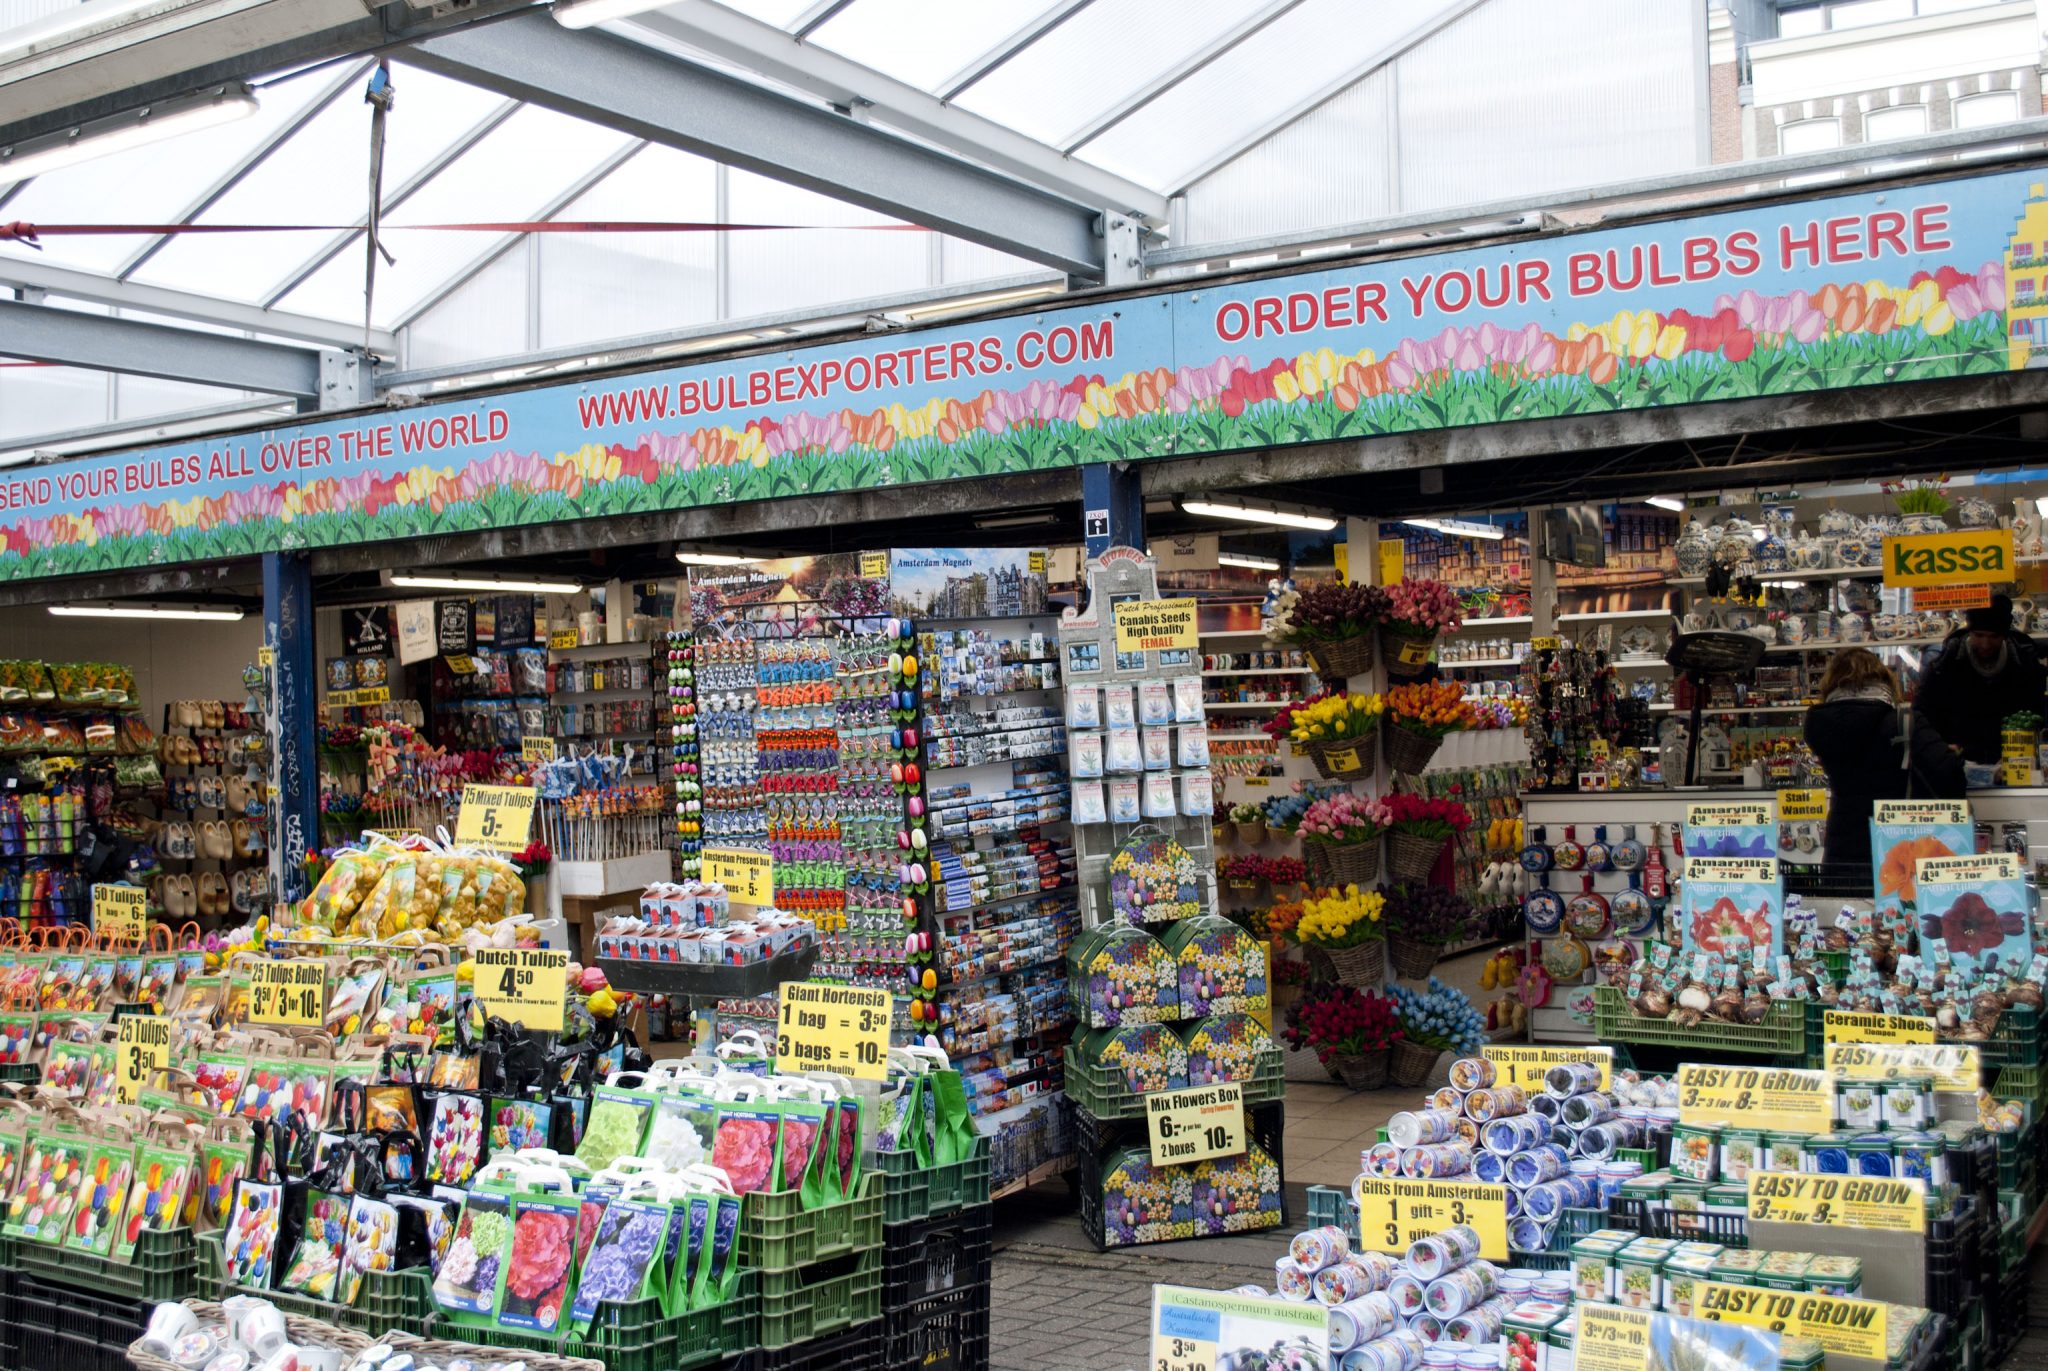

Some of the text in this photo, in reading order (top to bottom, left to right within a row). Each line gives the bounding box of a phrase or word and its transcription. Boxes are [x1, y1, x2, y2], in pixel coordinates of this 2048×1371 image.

[1214, 205, 1952, 342] ORDER YOUR BULBS HERE
[578, 320, 1114, 429] WWW.BULBEXPORTERS.COM
[0, 408, 510, 511] SEND YOUR BULBS ALL OVER THE WORLD
[897, 558, 940, 569] Amsterdam
[942, 558, 973, 568] Magnets
[1100, 548, 1144, 567] growers
[1894, 543, 2004, 575] kassa
[698, 573, 786, 586] Amsterdam Magnets
[1115, 600, 1195, 613] Dutch Professionals
[1120, 612, 1190, 626] Canabis Seeds
[1127, 625, 1184, 638] High Quality
[357, 644, 383, 654] HOLLAND
[1140, 637, 1174, 649] FEMALE
[524, 739, 552, 750] Mills
[463, 787, 534, 809] 75 Mixed Tulips
[1785, 793, 1810, 802] Staff
[1693, 805, 1766, 814] Amaryllis
[1782, 805, 1823, 815] Wanted
[1881, 803, 1962, 812] Amaryllis
[1727, 817, 1742, 825] for
[1918, 815, 1935, 823] for
[704, 852, 770, 866] Amsterdam Present box
[1692, 859, 1771, 868] Amaryllis
[1924, 857, 2010, 869] Amaryllis
[724, 868, 734, 877] box
[1728, 871, 1744, 879] for
[1964, 872, 1982, 880] for
[95, 887, 144, 905] 50 Tulips
[1687, 882, 1744, 896] Amaryllis
[96, 903, 101, 917] 1
[476, 950, 567, 968] Dutch Tulips
[252, 963, 323, 985] 25 Tulips Bulbs
[788, 985, 885, 1007] Giant Hortensia
[288, 996, 299, 1011] for
[783, 1003, 791, 1024] 1
[798, 1010, 826, 1029] bag
[1825, 1012, 1933, 1032] Ceramic Shoes
[119, 1017, 169, 1045] 25 Tulips
[1864, 1028, 1896, 1037] Klompen
[778, 1034, 790, 1056] 3
[795, 1041, 831, 1061] bags
[1484, 1049, 1608, 1063] Gifts from Amsterdam
[1832, 1048, 1876, 1065] EASY
[800, 1062, 855, 1076] Export Quality
[1507, 1064, 1515, 1083] 1
[1683, 1068, 1822, 1091] EASY TO GROW
[1151, 1088, 1239, 1112] Mix Flowers Box
[1706, 1098, 1714, 1107] 3
[1715, 1097, 1733, 1108] for
[1161, 1144, 1167, 1157] 2
[1169, 1142, 1196, 1156] boxes
[1362, 1180, 1504, 1201] Gifts from Amsterdam
[1752, 1176, 1911, 1205] EASY TO GROW
[531, 1203, 555, 1211] HORTENSIA
[1388, 1198, 1398, 1221] 1
[1410, 1204, 1433, 1219] gift
[1779, 1210, 1789, 1220] 3
[1789, 1209, 1810, 1222] for
[1385, 1222, 1398, 1246] 3
[1701, 1286, 1763, 1314] EASY
[1764, 1293, 1795, 1318] TO
[1798, 1298, 1877, 1329] GROW
[1583, 1306, 1647, 1326] BUDDHA PALM
